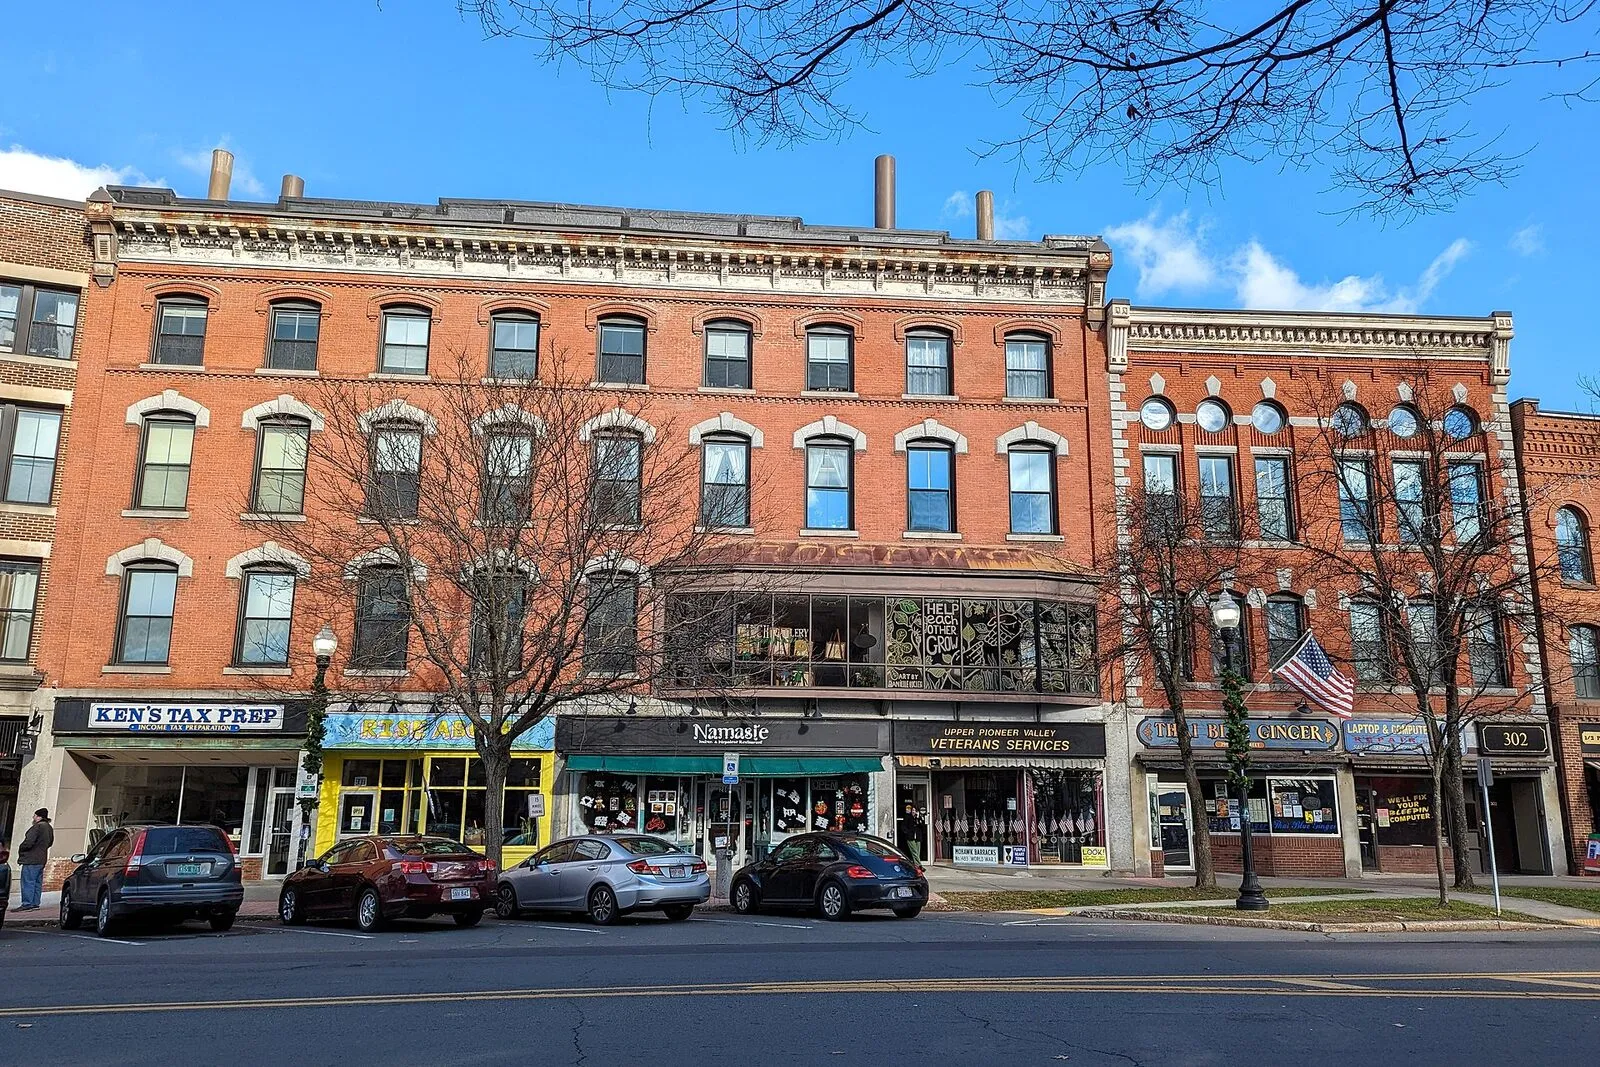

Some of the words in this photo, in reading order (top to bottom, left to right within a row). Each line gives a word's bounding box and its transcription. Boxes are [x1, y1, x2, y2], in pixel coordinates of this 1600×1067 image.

[926, 602, 959, 615] HELP
[927, 615, 959, 625] each
[927, 625, 957, 635] OTHER
[926, 635, 959, 655] GROW
[95, 705, 162, 723] KEN'S
[167, 708, 213, 723] TAX
[219, 708, 278, 724] PREP
[361, 719, 427, 740] RISE
[944, 728, 975, 736] UPPER
[978, 728, 1020, 737] PIONEER
[1023, 729, 1057, 738] VALLEY
[1155, 723, 1199, 739] THI
[1257, 725, 1324, 742] GINGER
[1347, 723, 1380, 734] LAPTOP
[1383, 725, 1389, 735] &
[1391, 725, 1430, 735] COMPUTE
[930, 738, 1000, 750] VETERANS
[1006, 739, 1070, 751] SERVICES
[1503, 732, 1529, 747] 302
[1397, 801, 1420, 809] YOUR
[974, 848, 997, 856] BARRACKS
[1082, 848, 1105, 856] LOOK!
